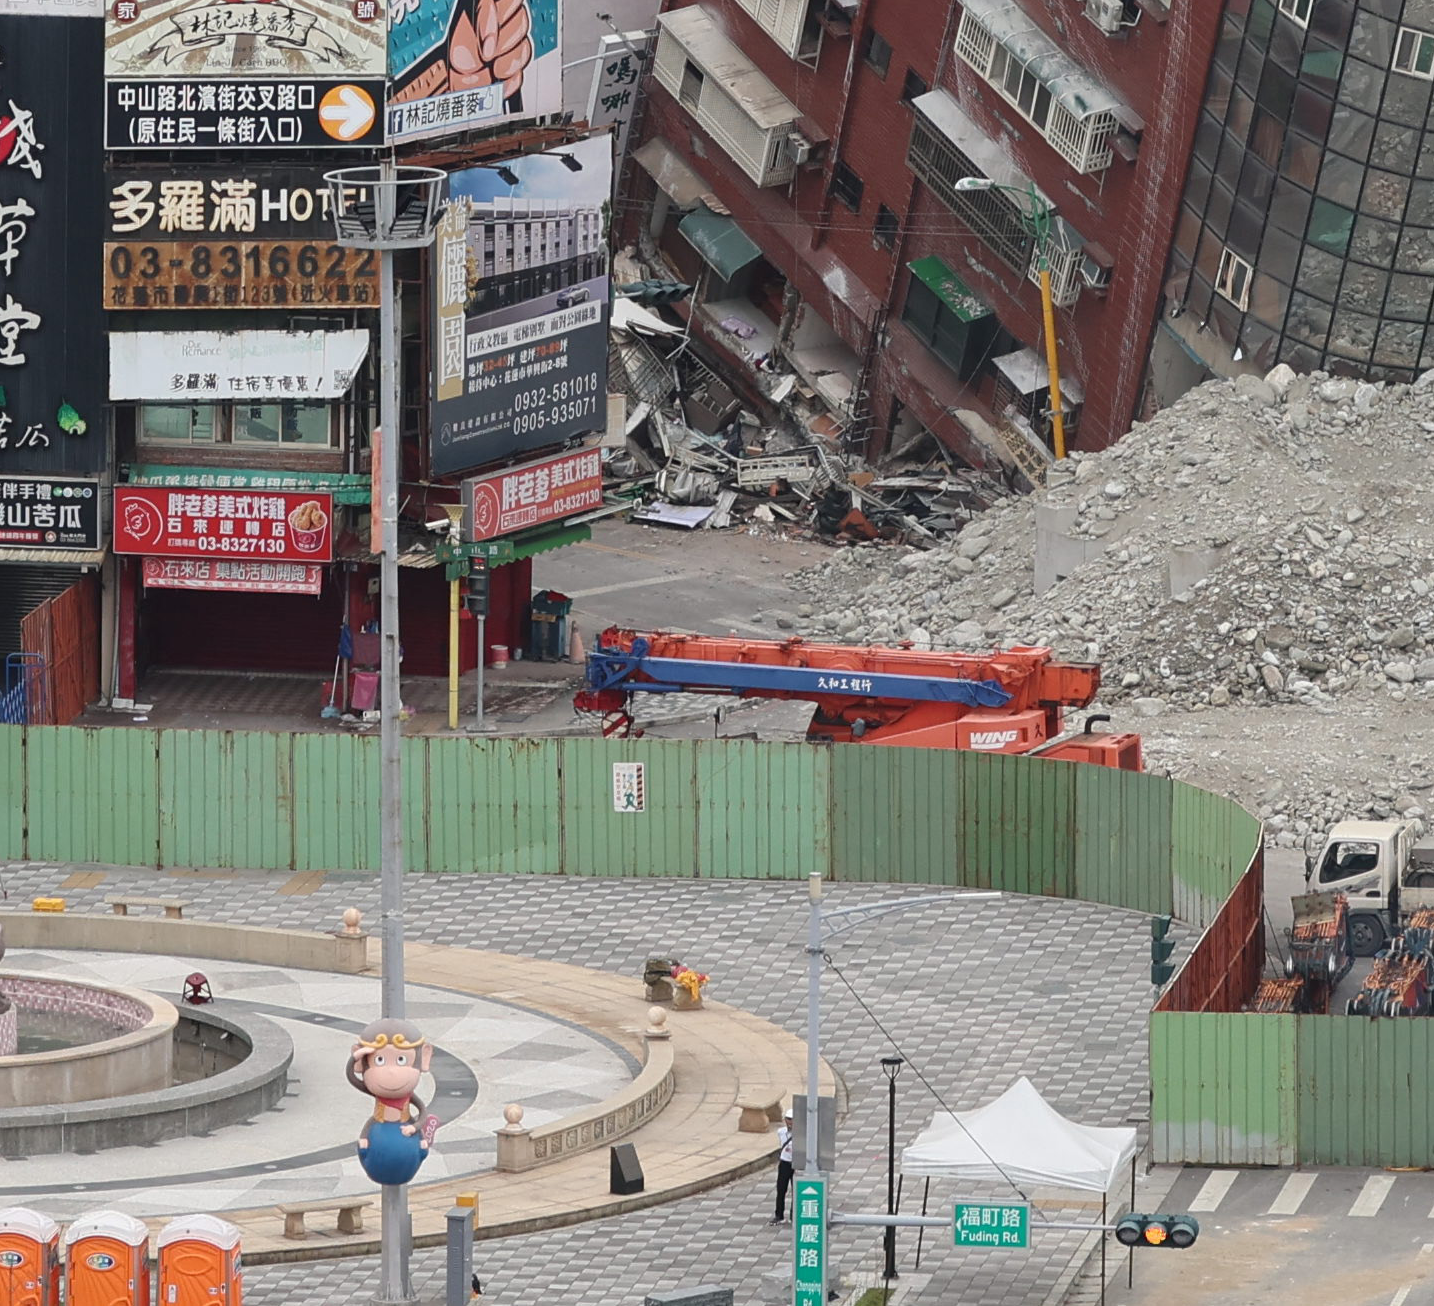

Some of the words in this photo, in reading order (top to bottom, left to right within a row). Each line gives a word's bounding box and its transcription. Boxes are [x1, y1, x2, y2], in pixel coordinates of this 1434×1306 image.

[190, 7, 304, 37] 林記燒番麥
[117, 84, 316, 112] 中山路北濱街交叉路口
[404, 91, 480, 129] 林記燒番麥
[128, 116, 303, 144] (原住民一條街入口)
[109, 178, 257, 233] 多羅滿
[110, 244, 376, 280] 03-8316622
[469, 330, 509, 355] 行政文教區
[513, 321, 546, 343] 電梯別墅
[550, 305, 596, 334] 面對公園綠地
[169, 372, 220, 393] 多羅滿
[514, 371, 599, 413] 0932-581018
[512, 395, 597, 437] 0905-935071
[167, 492, 286, 521] 胖老爹美式炸雞
[553, 488, 601, 514] 03-8327130
[197, 536, 286, 554] 03-8327130
[164, 559, 211, 578] 石來店
[817, 676, 873, 693] 久和工程行
[970, 730, 1019, 744] WING
[961, 1206, 1022, 1228] 福町路
[799, 1198, 820, 1268] 重慶路
[960, 1230, 1000, 1246] Fuding
[1002, 1231, 1022, 1244] Rd.
